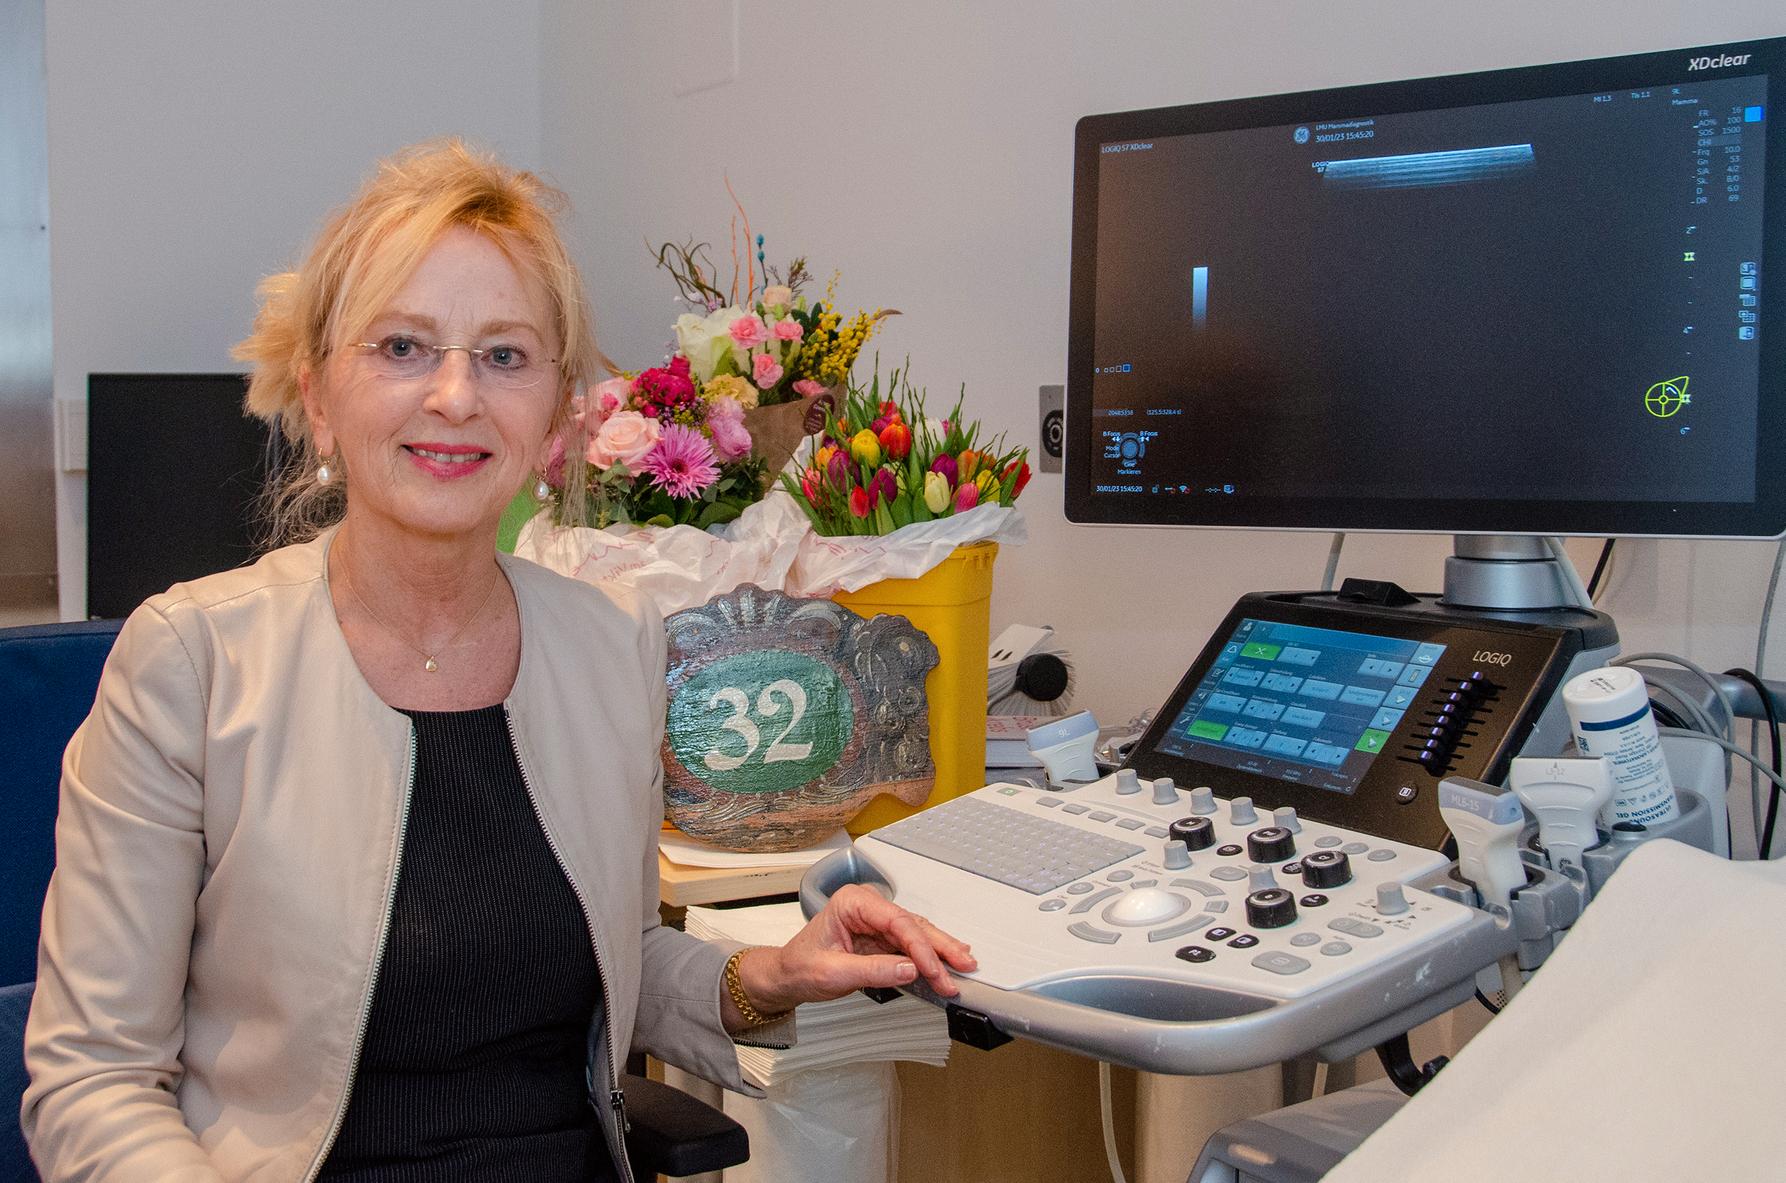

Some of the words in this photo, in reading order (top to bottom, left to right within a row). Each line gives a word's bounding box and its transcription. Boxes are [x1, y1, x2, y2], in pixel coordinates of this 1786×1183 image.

[1688, 53, 1752, 71] XDclear
[1472, 650, 1512, 668] LOGIQ
[703, 679, 813, 771] 32
